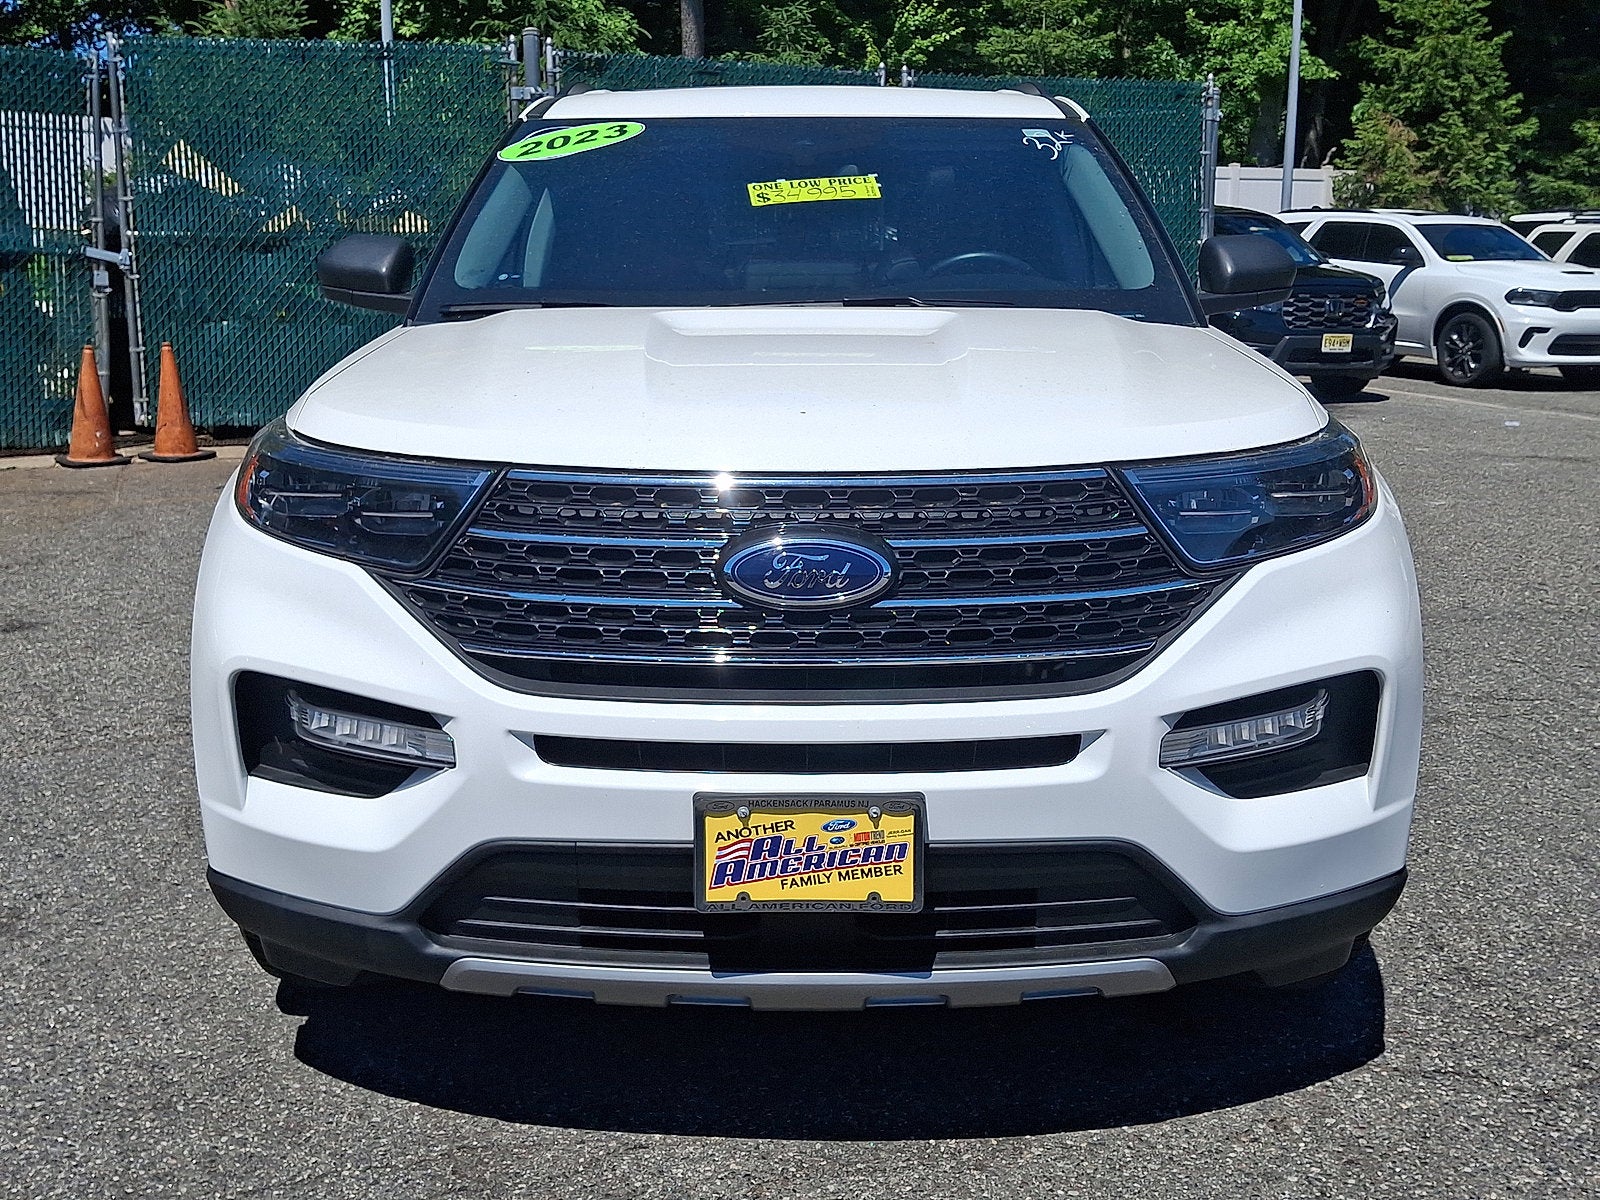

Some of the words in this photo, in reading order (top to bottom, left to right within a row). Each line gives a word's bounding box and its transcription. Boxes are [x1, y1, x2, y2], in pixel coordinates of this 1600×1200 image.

[516, 124, 628, 158] 2023
[752, 182, 784, 191] ONE
[790, 179, 821, 189] LOW
[829, 176, 872, 186] PRICE
[763, 552, 853, 589] Ford
[857, 800, 870, 808] NJ
[714, 820, 796, 844] ANOTHER
[749, 835, 827, 862] ALL
[711, 842, 911, 888] AMERICAN
[780, 871, 833, 890] FAMILY
[838, 865, 903, 882] MEMBER
[706, 903, 738, 911] ALL
[749, 902, 852, 911] AMERICAN
[855, 902, 914, 911] FORD
